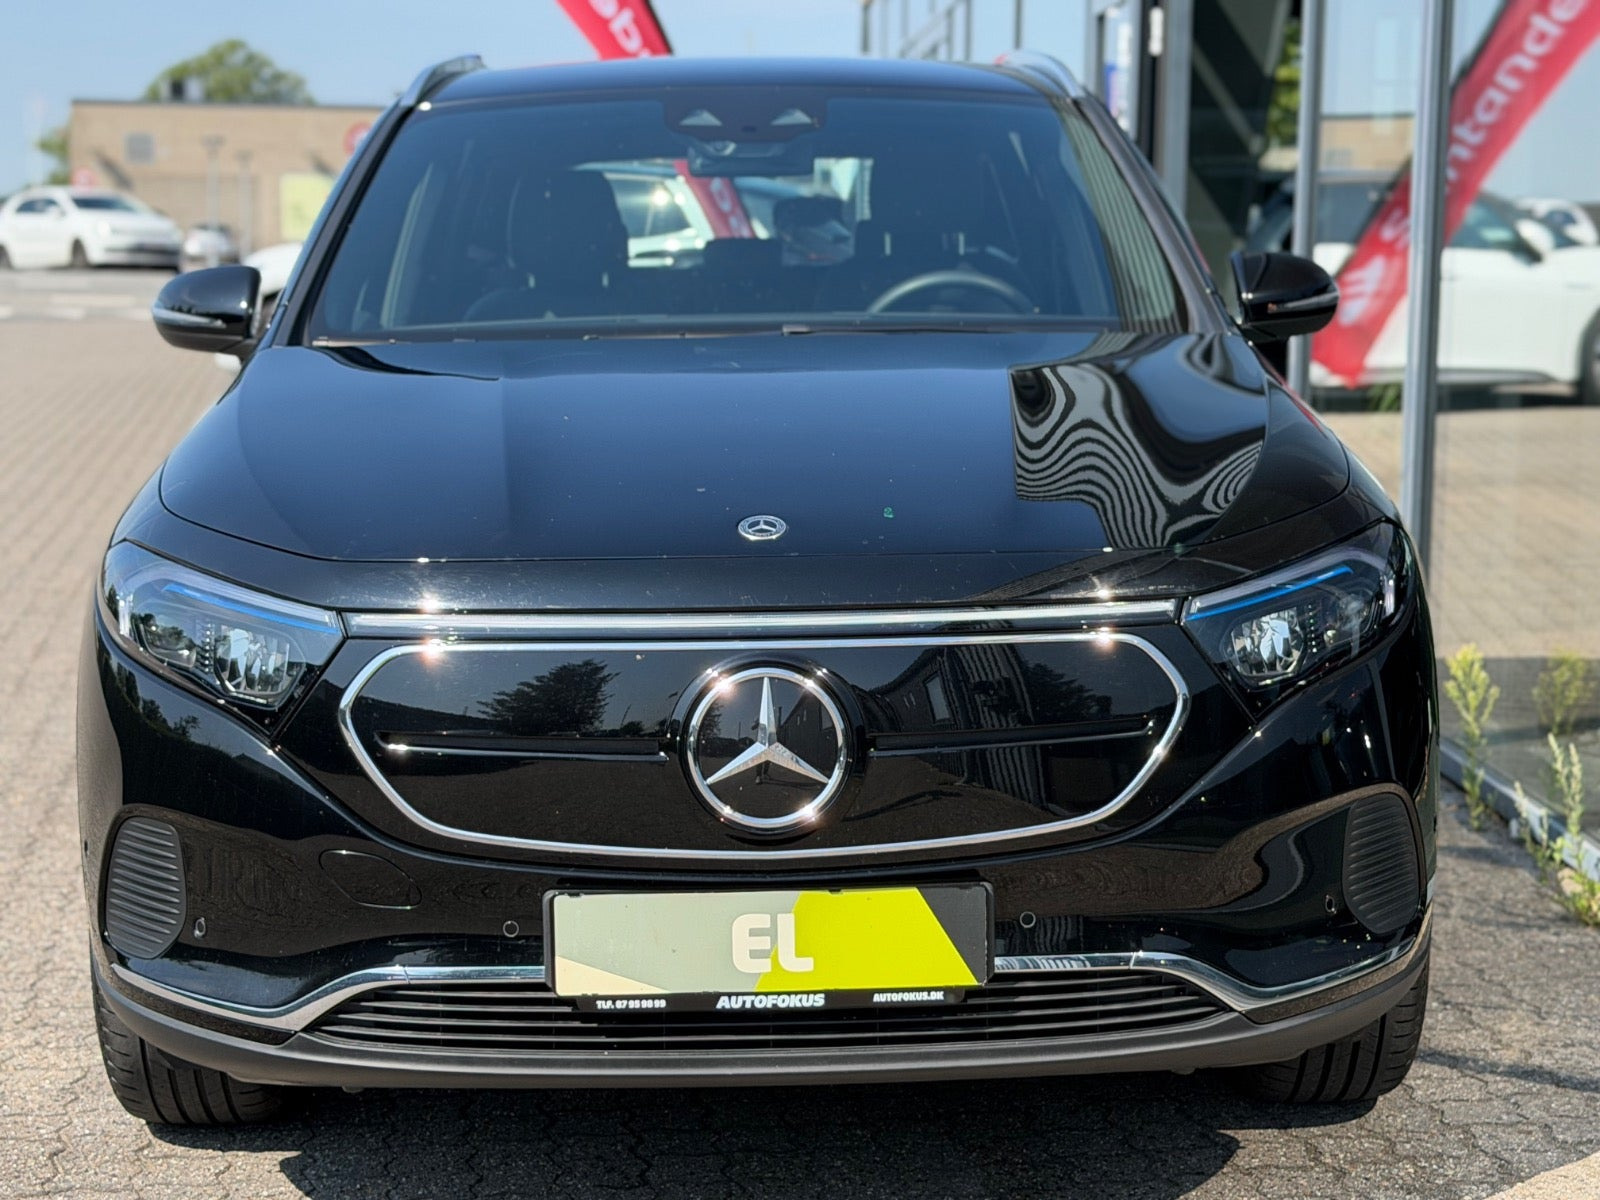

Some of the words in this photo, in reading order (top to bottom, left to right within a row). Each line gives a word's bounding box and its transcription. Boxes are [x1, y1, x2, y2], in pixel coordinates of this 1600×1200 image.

[732, 913, 814, 973] EL
[715, 993, 826, 1009] AUTOFOKUS
[872, 991, 945, 1003] AUTOFOKUS.DK
